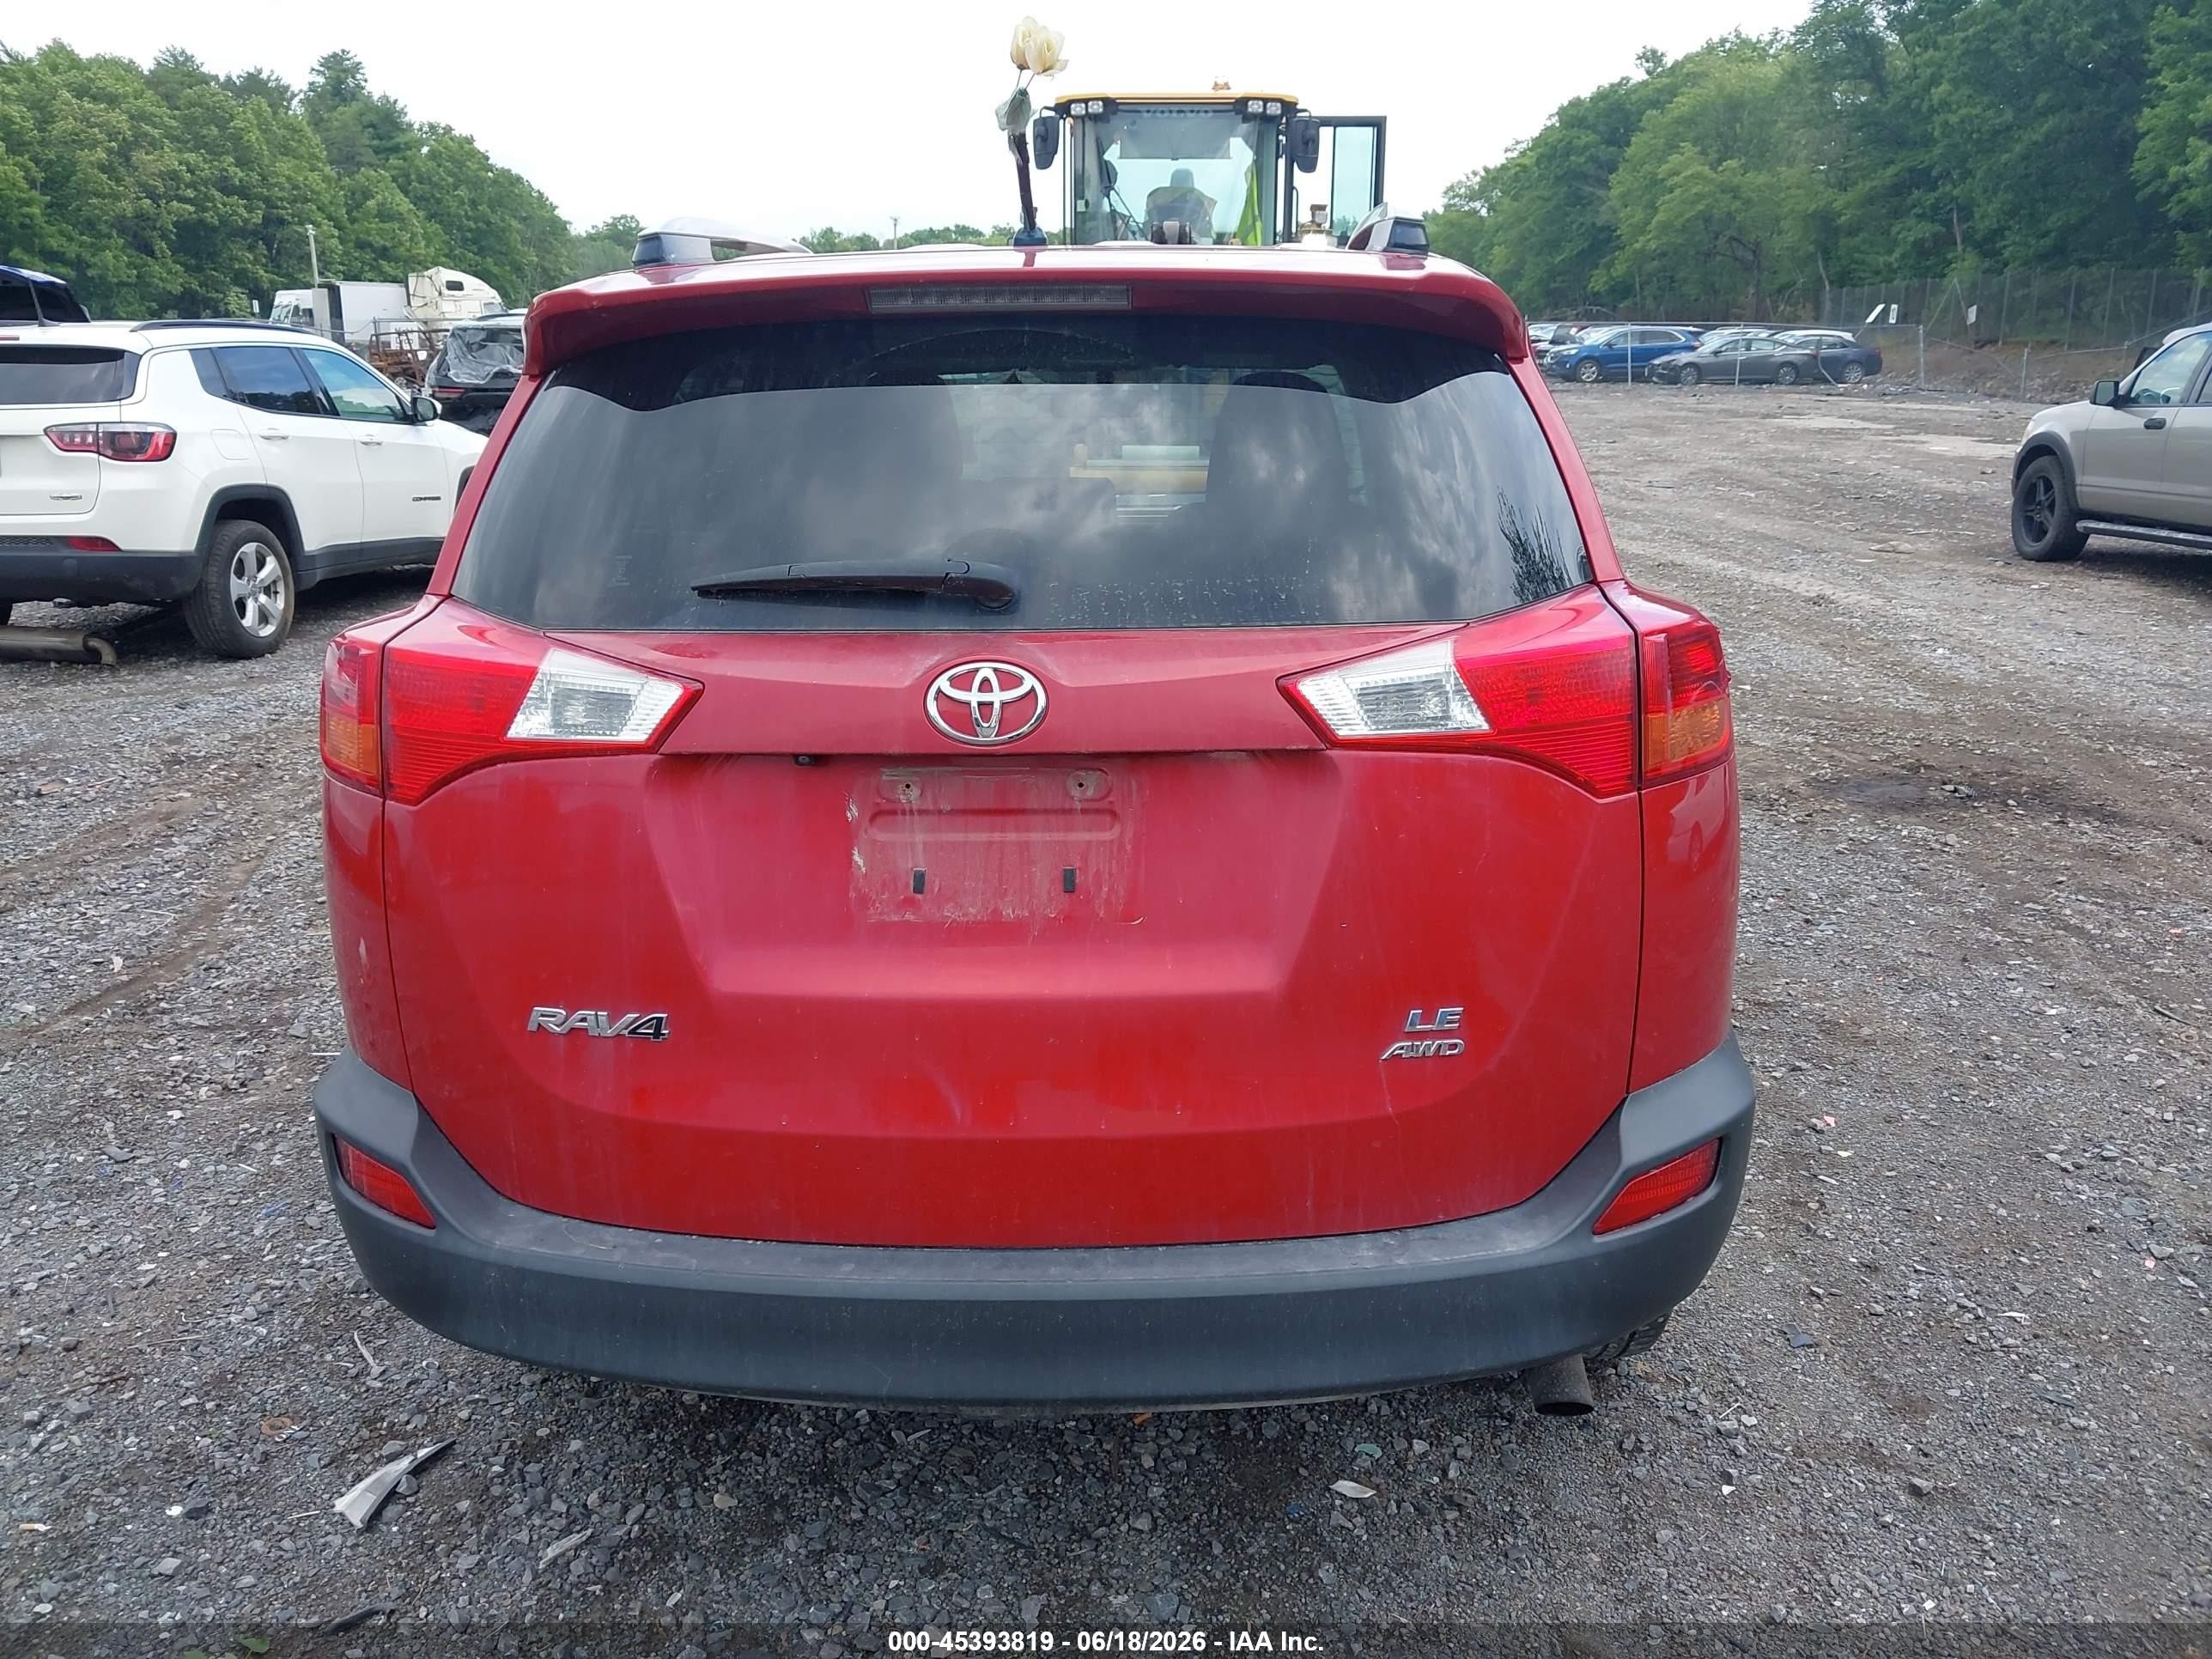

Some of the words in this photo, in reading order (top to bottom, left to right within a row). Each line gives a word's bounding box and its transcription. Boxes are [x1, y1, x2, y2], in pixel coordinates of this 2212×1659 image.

[527, 1006, 669, 1042] RAV4
[1404, 1007, 1464, 1032] LE
[1380, 1039, 1465, 1060] AWD
